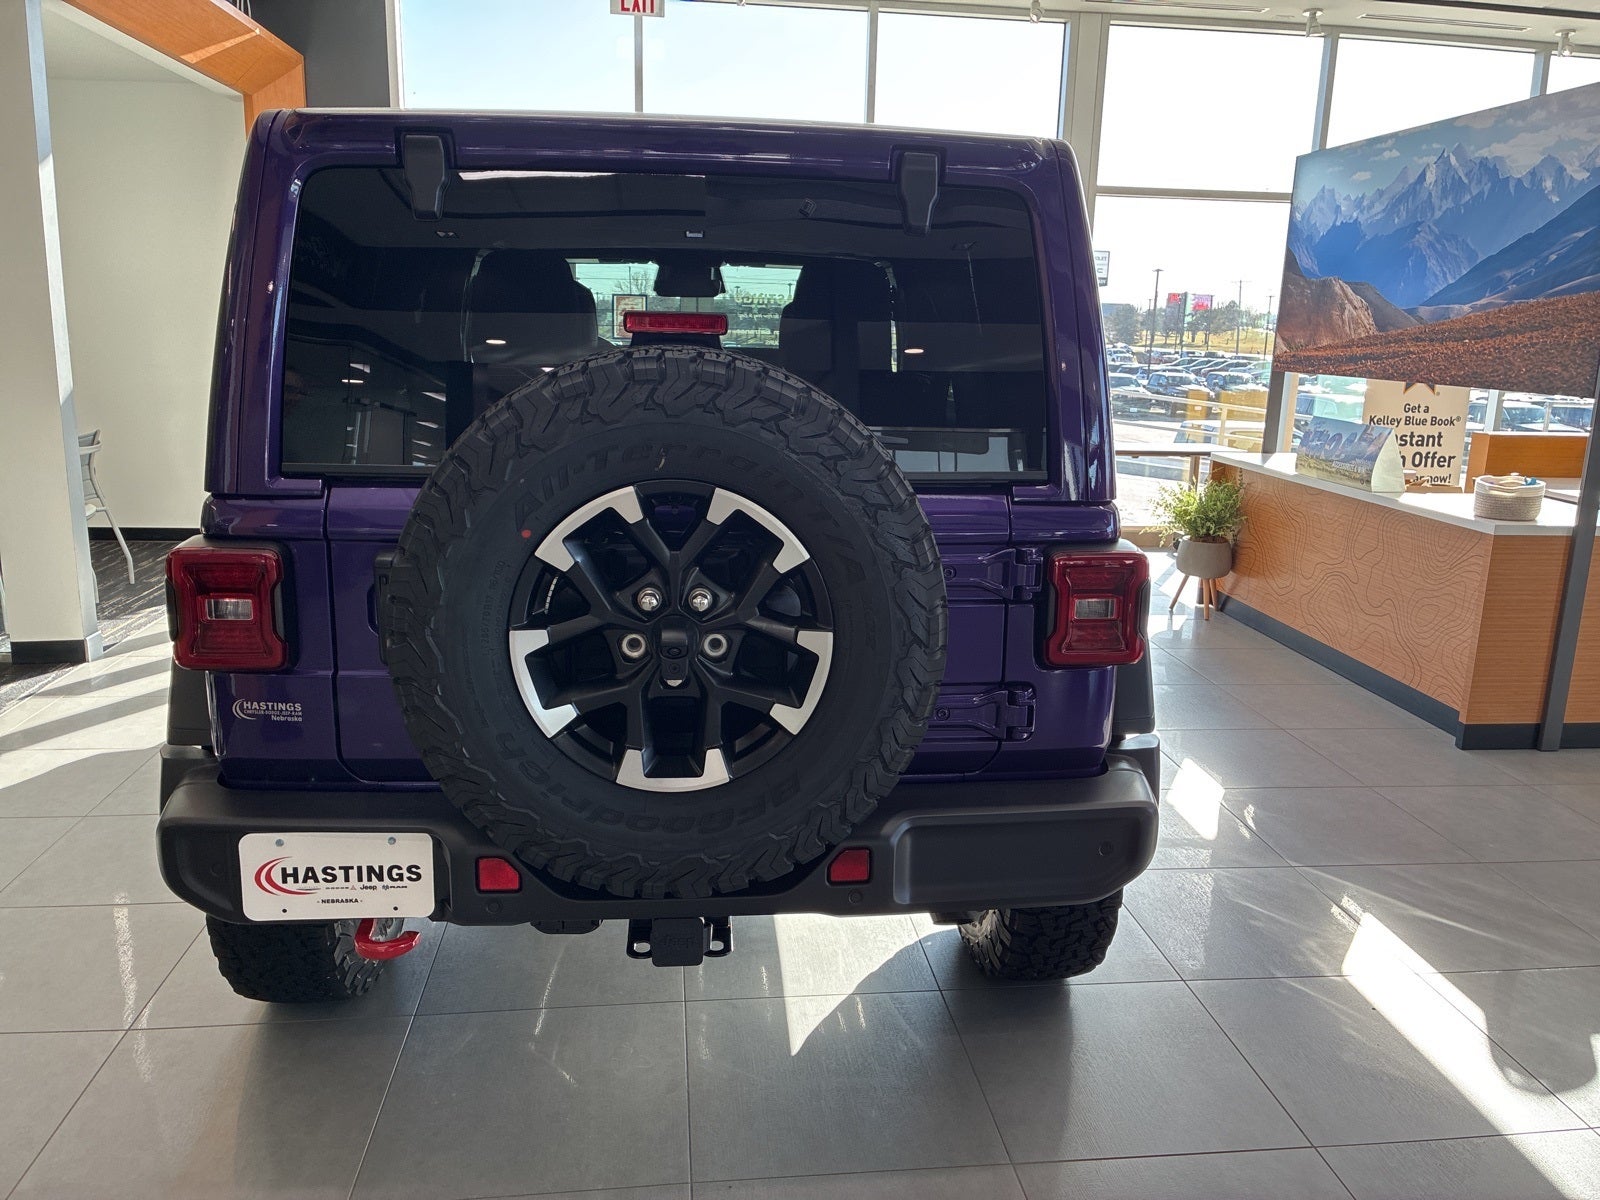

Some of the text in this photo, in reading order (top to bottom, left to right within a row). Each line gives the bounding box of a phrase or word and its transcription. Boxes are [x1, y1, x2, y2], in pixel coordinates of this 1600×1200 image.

[1403, 402, 1430, 414] Get a
[1368, 415, 1402, 428] Kelley
[1404, 416, 1427, 426] Blue
[1395, 431, 1443, 447] stant
[1411, 451, 1456, 468] Offer
[243, 701, 302, 711] HASTINGS
[281, 864, 422, 884] HASTINGS
